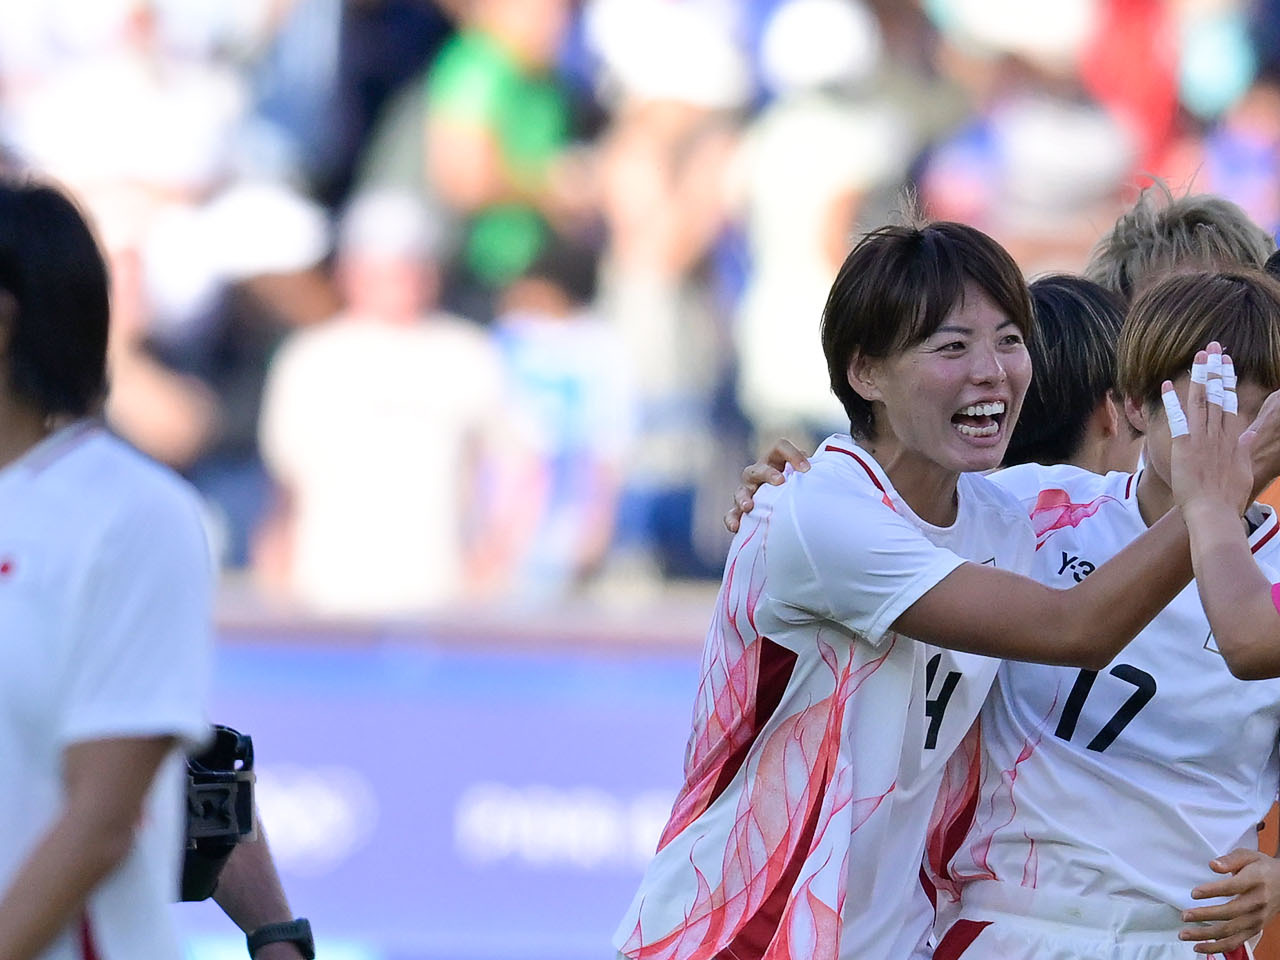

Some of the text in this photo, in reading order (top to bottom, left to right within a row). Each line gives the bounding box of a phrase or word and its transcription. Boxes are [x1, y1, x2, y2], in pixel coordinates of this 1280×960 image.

[1058, 551, 1096, 583] Y-3
[924, 653, 963, 749] 4
[1055, 663, 1157, 752] 17
